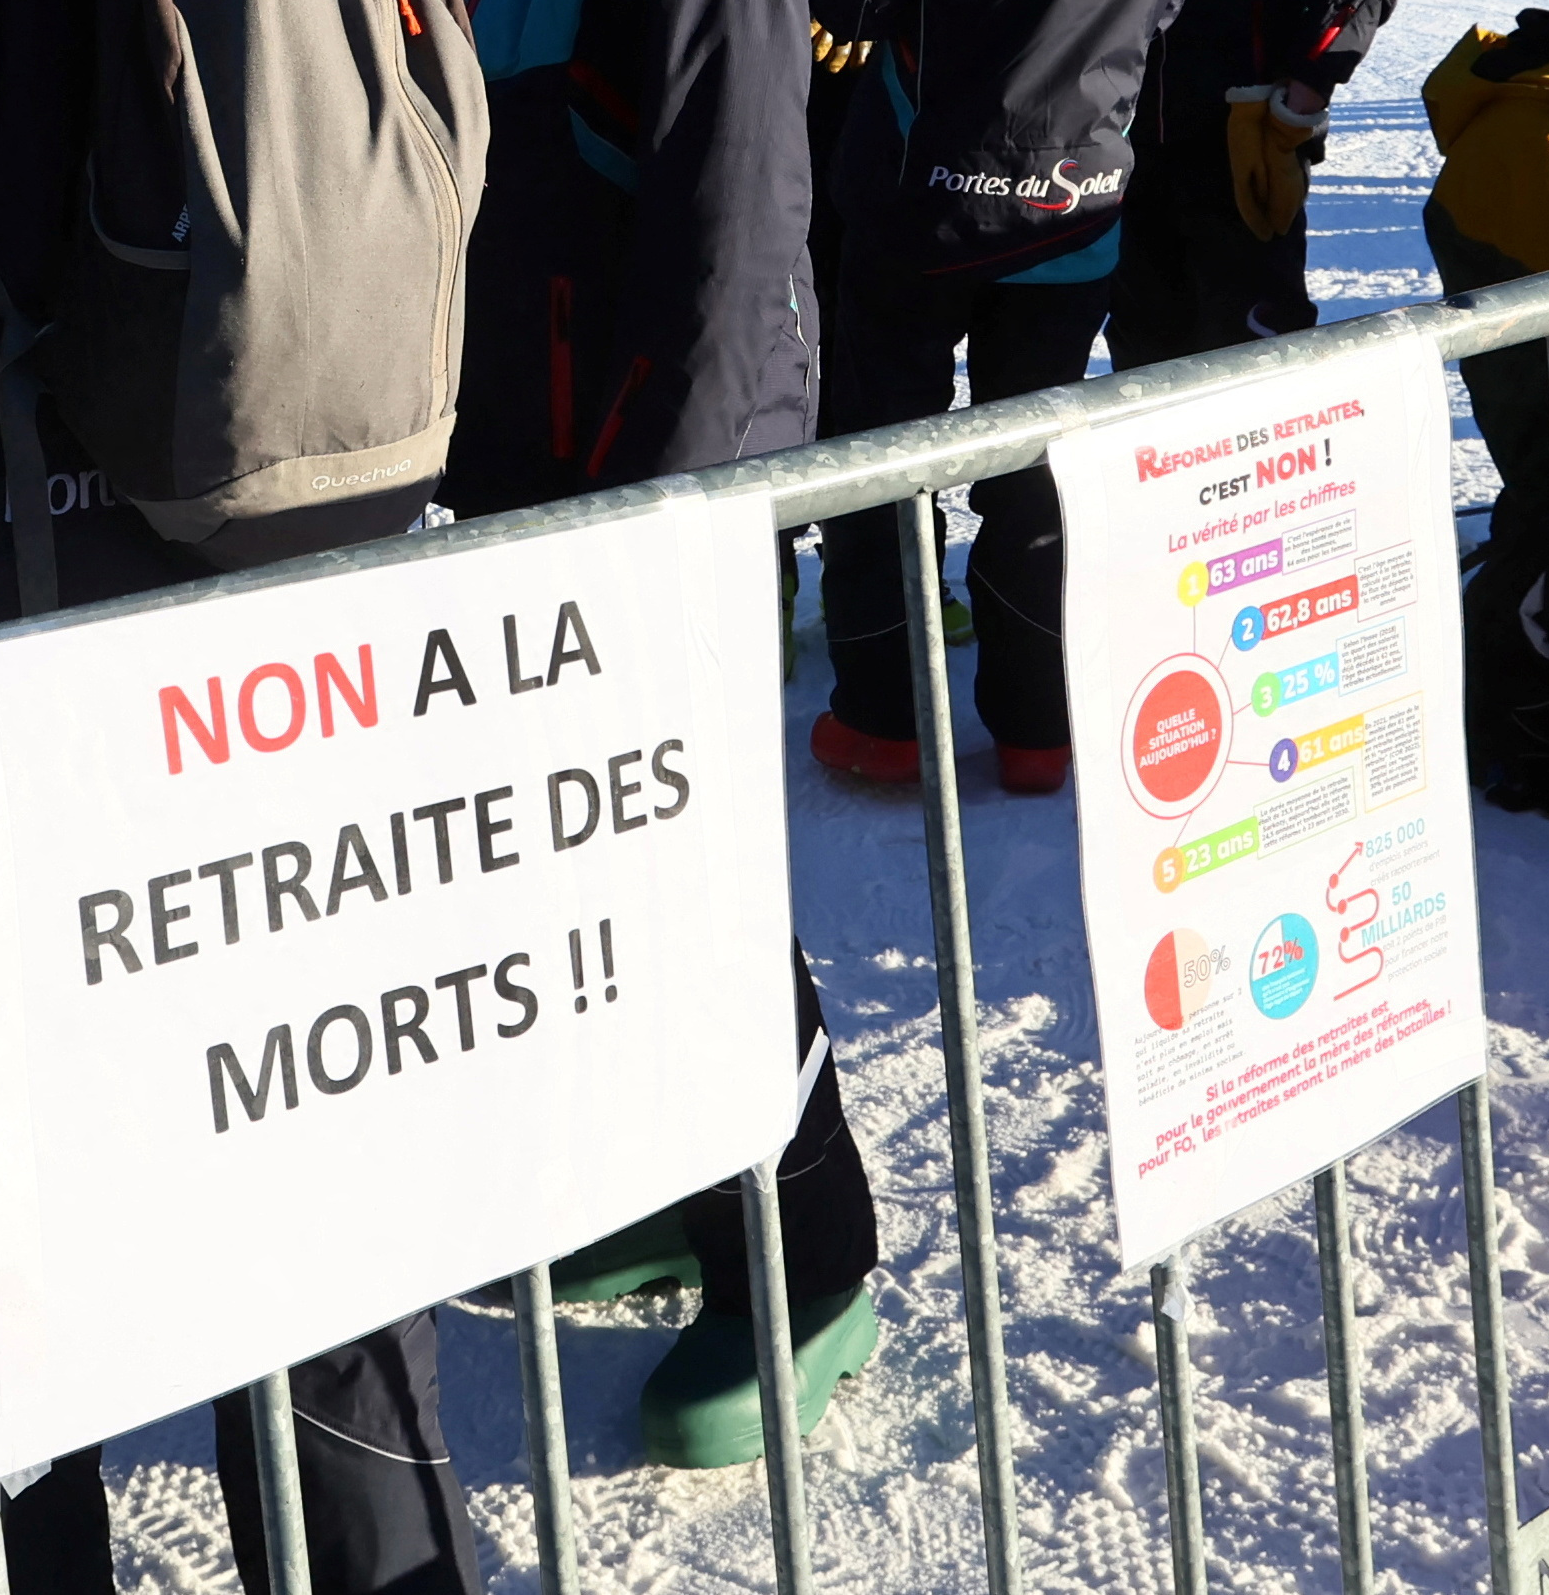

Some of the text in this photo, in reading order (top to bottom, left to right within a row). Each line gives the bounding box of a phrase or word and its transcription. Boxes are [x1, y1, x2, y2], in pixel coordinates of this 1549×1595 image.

[928, 157, 1122, 215] Portes du Soleil
[1236, 428, 1269, 452] DES
[1273, 399, 1365, 440] RETRAITES,
[312, 458, 412, 491] Quechua
[1199, 438, 1332, 505] C'EST NON !
[1169, 481, 1356, 553] La vérité par les chiffres
[1210, 549, 1277, 587] 63 ans
[1242, 616, 1253, 641] 2
[1267, 588, 1351, 635] 62,8 ans
[158, 599, 602, 776] NON A LA
[1260, 685, 1272, 709] 3
[1283, 658, 1334, 700] 25 %
[1149, 719, 1204, 750] SITUATION
[1156, 708, 1195, 732] QUELLE
[1139, 733, 1208, 769] AUJOURD'HUI
[1278, 748, 1289, 773] 4
[1300, 725, 1363, 764] 61 ans
[1186, 829, 1253, 874] 23 ans
[1366, 818, 1425, 858] 825 000
[77, 738, 691, 987] RETRAITE DES
[1162, 857, 1174, 883] 5
[1392, 881, 1411, 906] 50
[1360, 892, 1446, 948] MILLIARDS
[1425, 922, 1434, 931] de
[1183, 945, 1231, 989] 50%
[1259, 933, 1304, 974] 72%
[205, 918, 619, 1135] MORTS !!
[1193, 1010, 1224, 1029] retraite
[1206, 1001, 1389, 1102] Si la réforme des retraites est
[1138, 1150, 1170, 1179] pour
[1174, 1136, 1196, 1156] FO,
[1202, 1125, 1220, 1142] les
[1283, 1071, 1324, 1101] seront
[1326, 1065, 1338, 1079] la
[1341, 1047, 1371, 1071] mère
[1374, 1035, 1395, 1053] des
[1396, 1007, 1445, 1041] batailles
[1156, 999, 1431, 1150] pour le gouvernement la mère des réformes,
